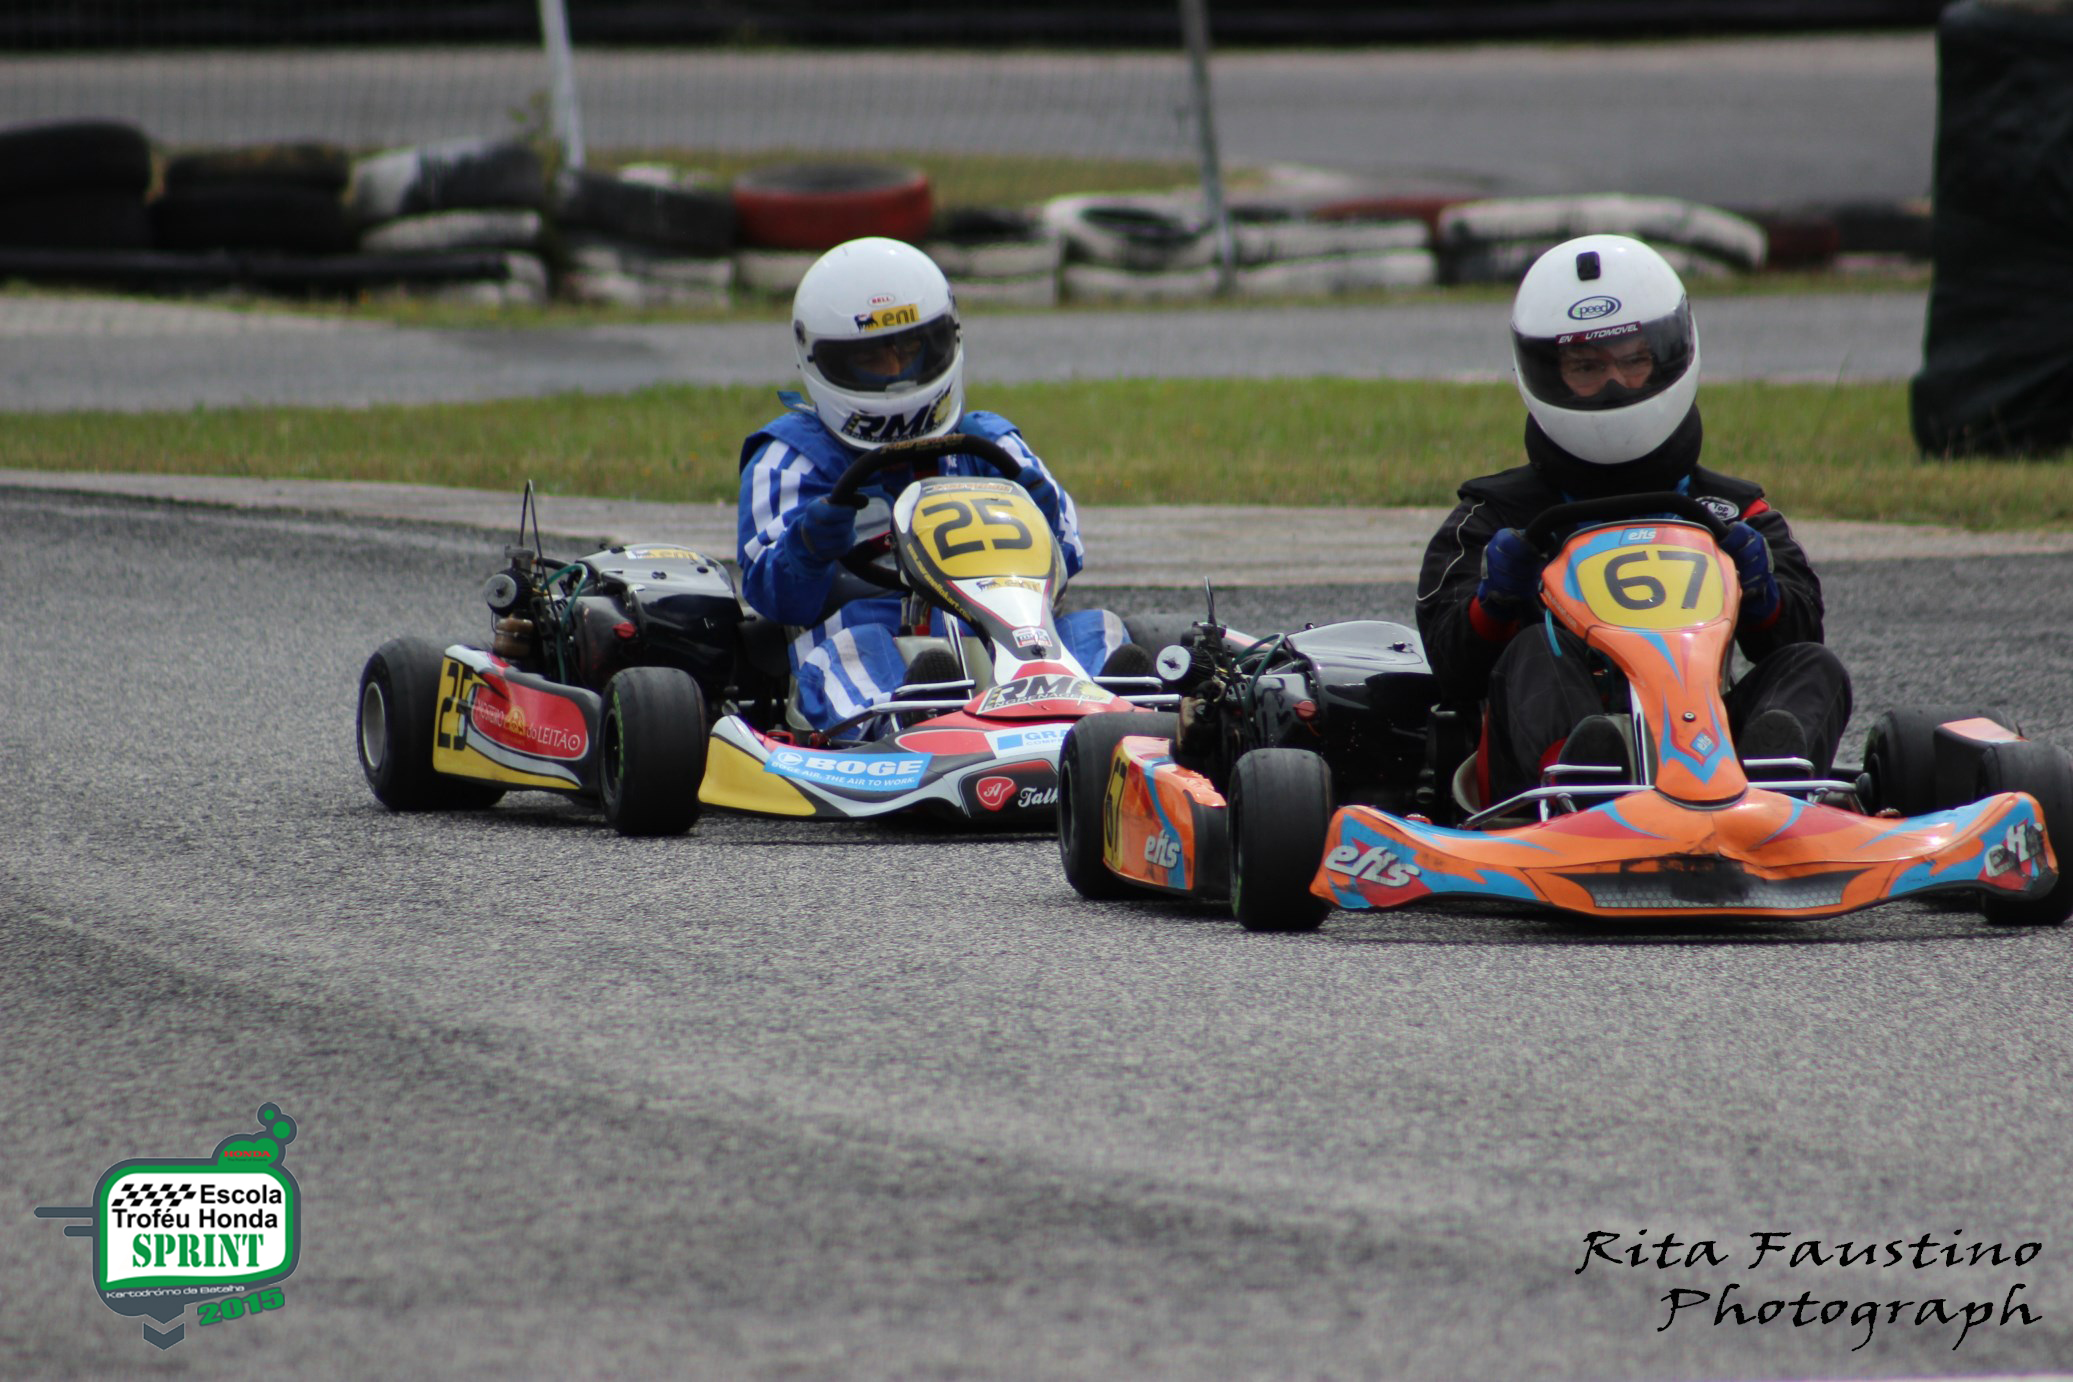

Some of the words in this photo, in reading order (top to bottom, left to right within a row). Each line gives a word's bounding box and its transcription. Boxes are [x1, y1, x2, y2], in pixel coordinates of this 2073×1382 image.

[881, 307, 916, 327] eni
[1578, 324, 1639, 340] UTOMOVEL
[922, 498, 1033, 561] 25
[1604, 550, 1709, 610] 67
[538, 726, 581, 751] LEITÃO
[805, 757, 924, 776] BOGE
[825, 774, 844, 784] THE
[847, 778, 865, 786] AIR
[869, 779, 882, 787] TO
